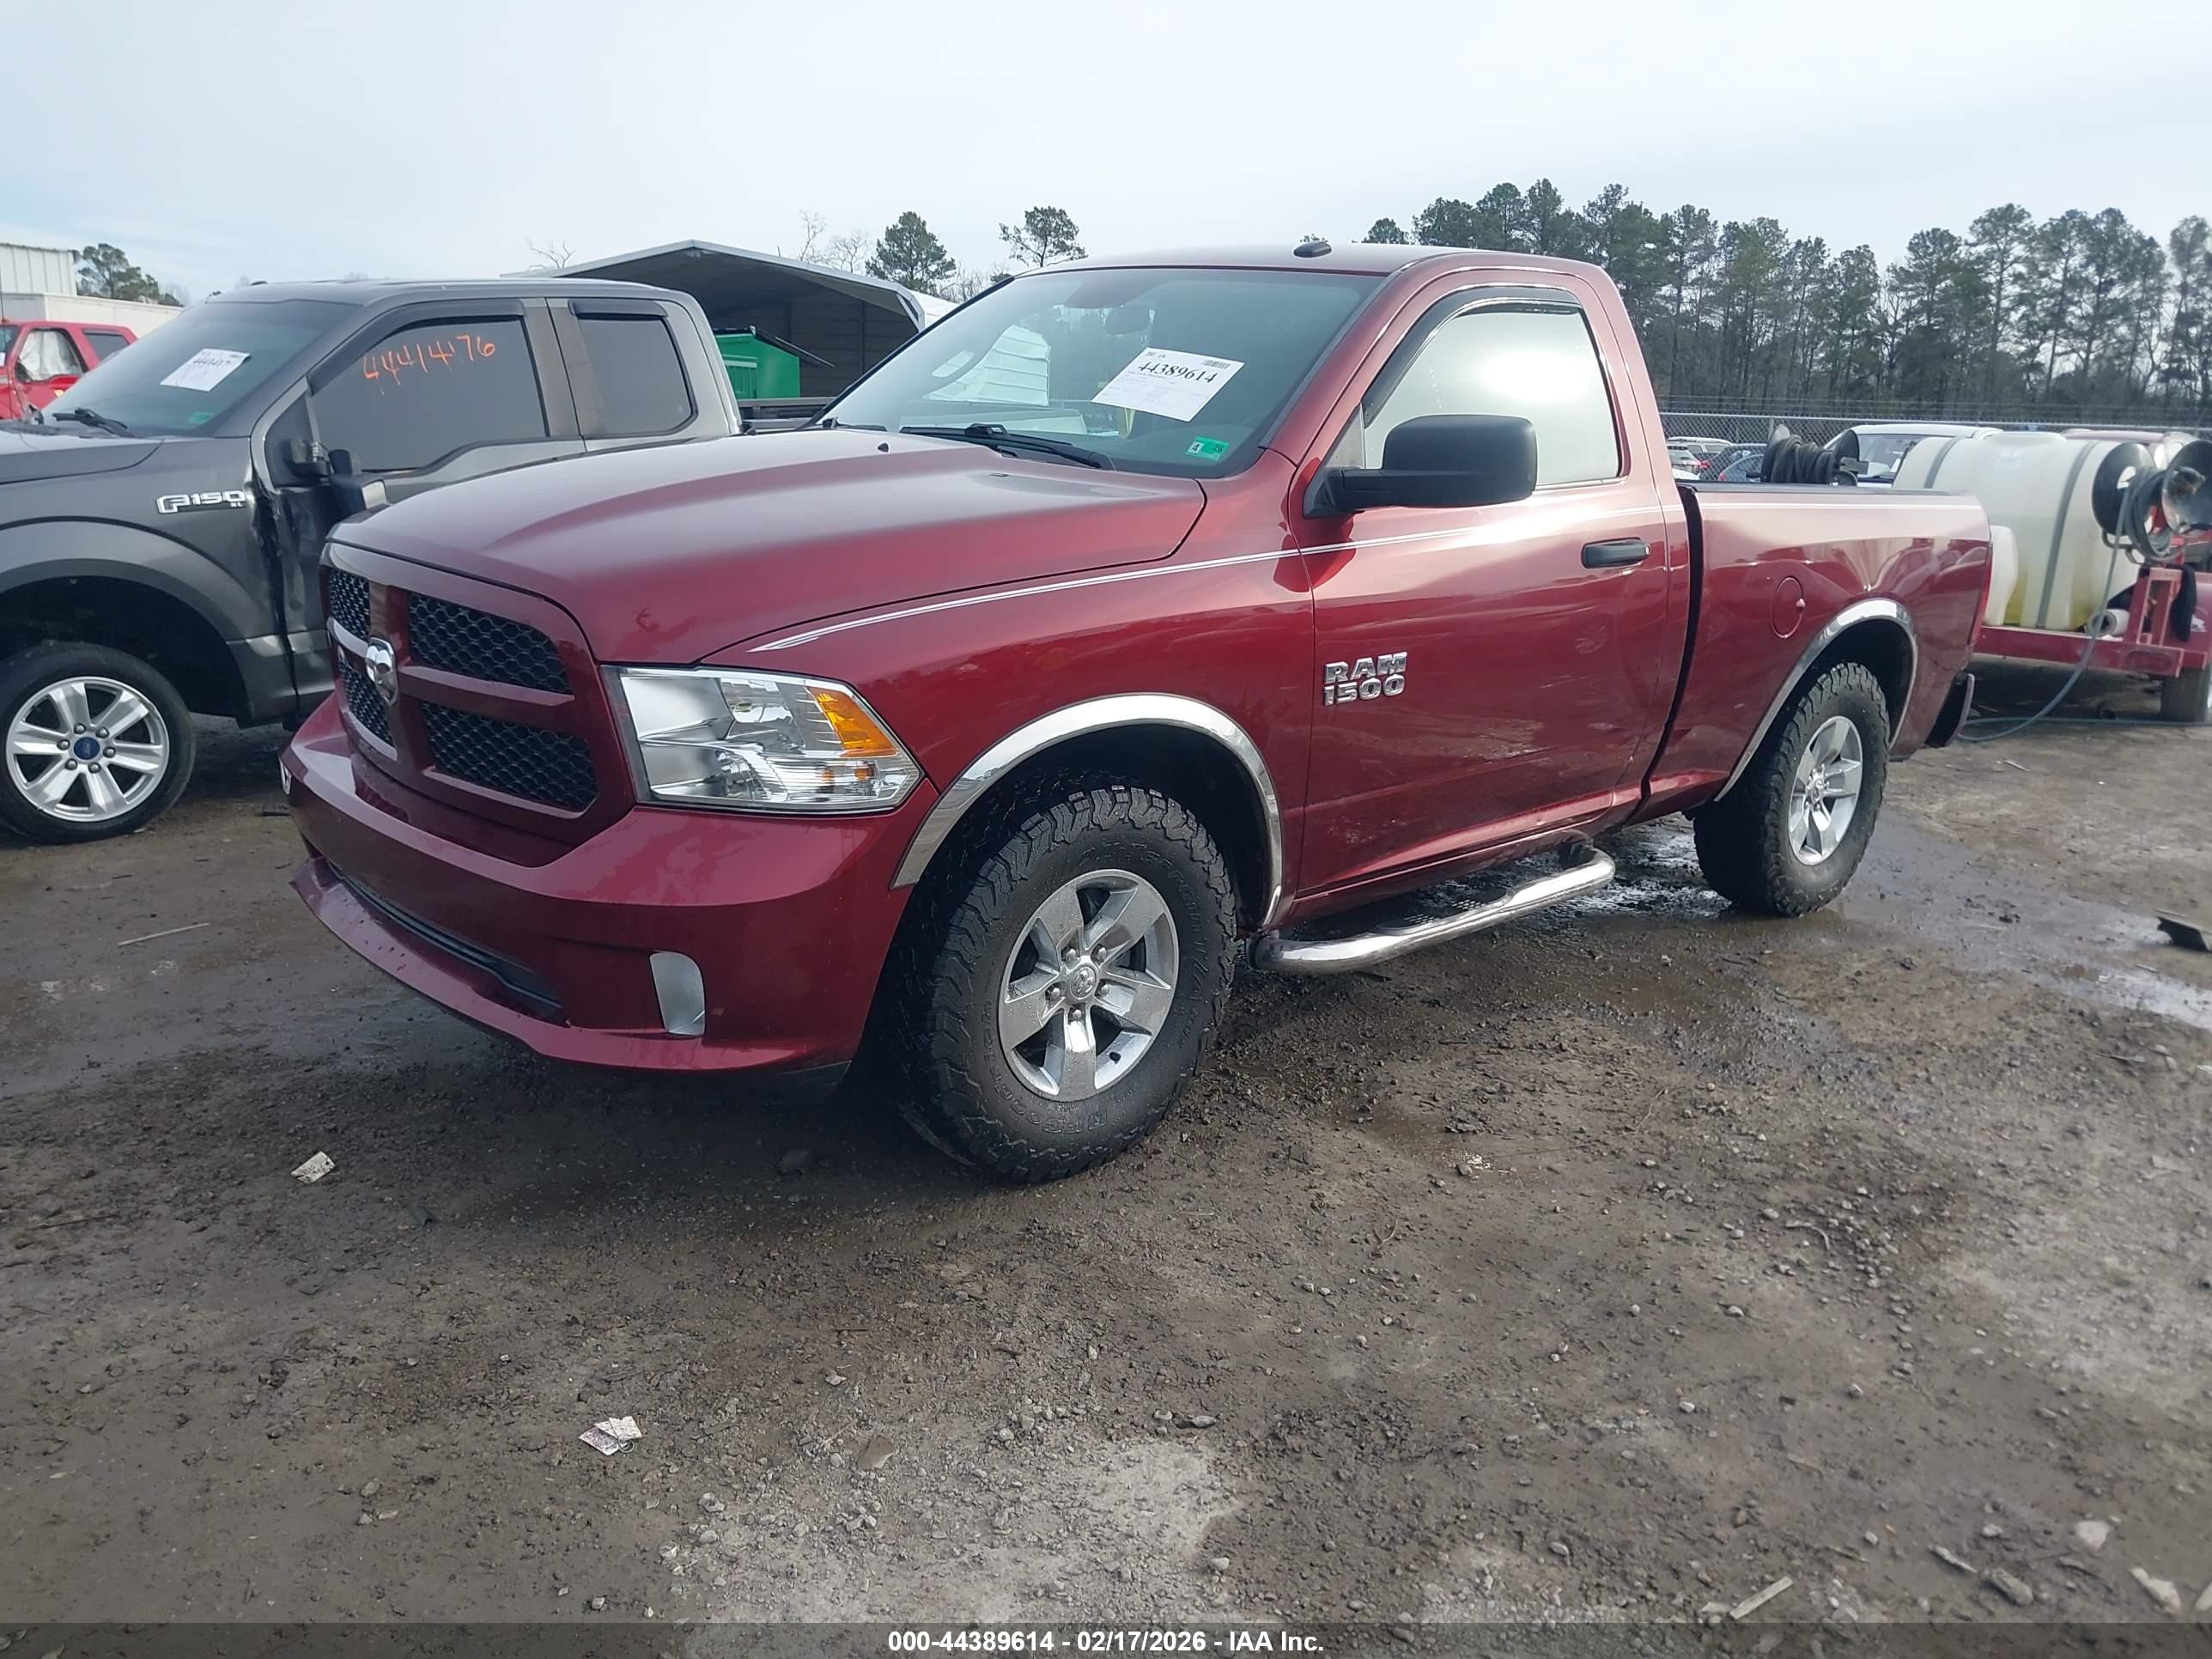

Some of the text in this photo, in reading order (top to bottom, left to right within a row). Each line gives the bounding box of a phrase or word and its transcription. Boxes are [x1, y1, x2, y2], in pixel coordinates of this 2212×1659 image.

[1138, 361, 1218, 383] 44389614
[1325, 651, 1408, 684] RAM
[1323, 673, 1406, 707] 1500
